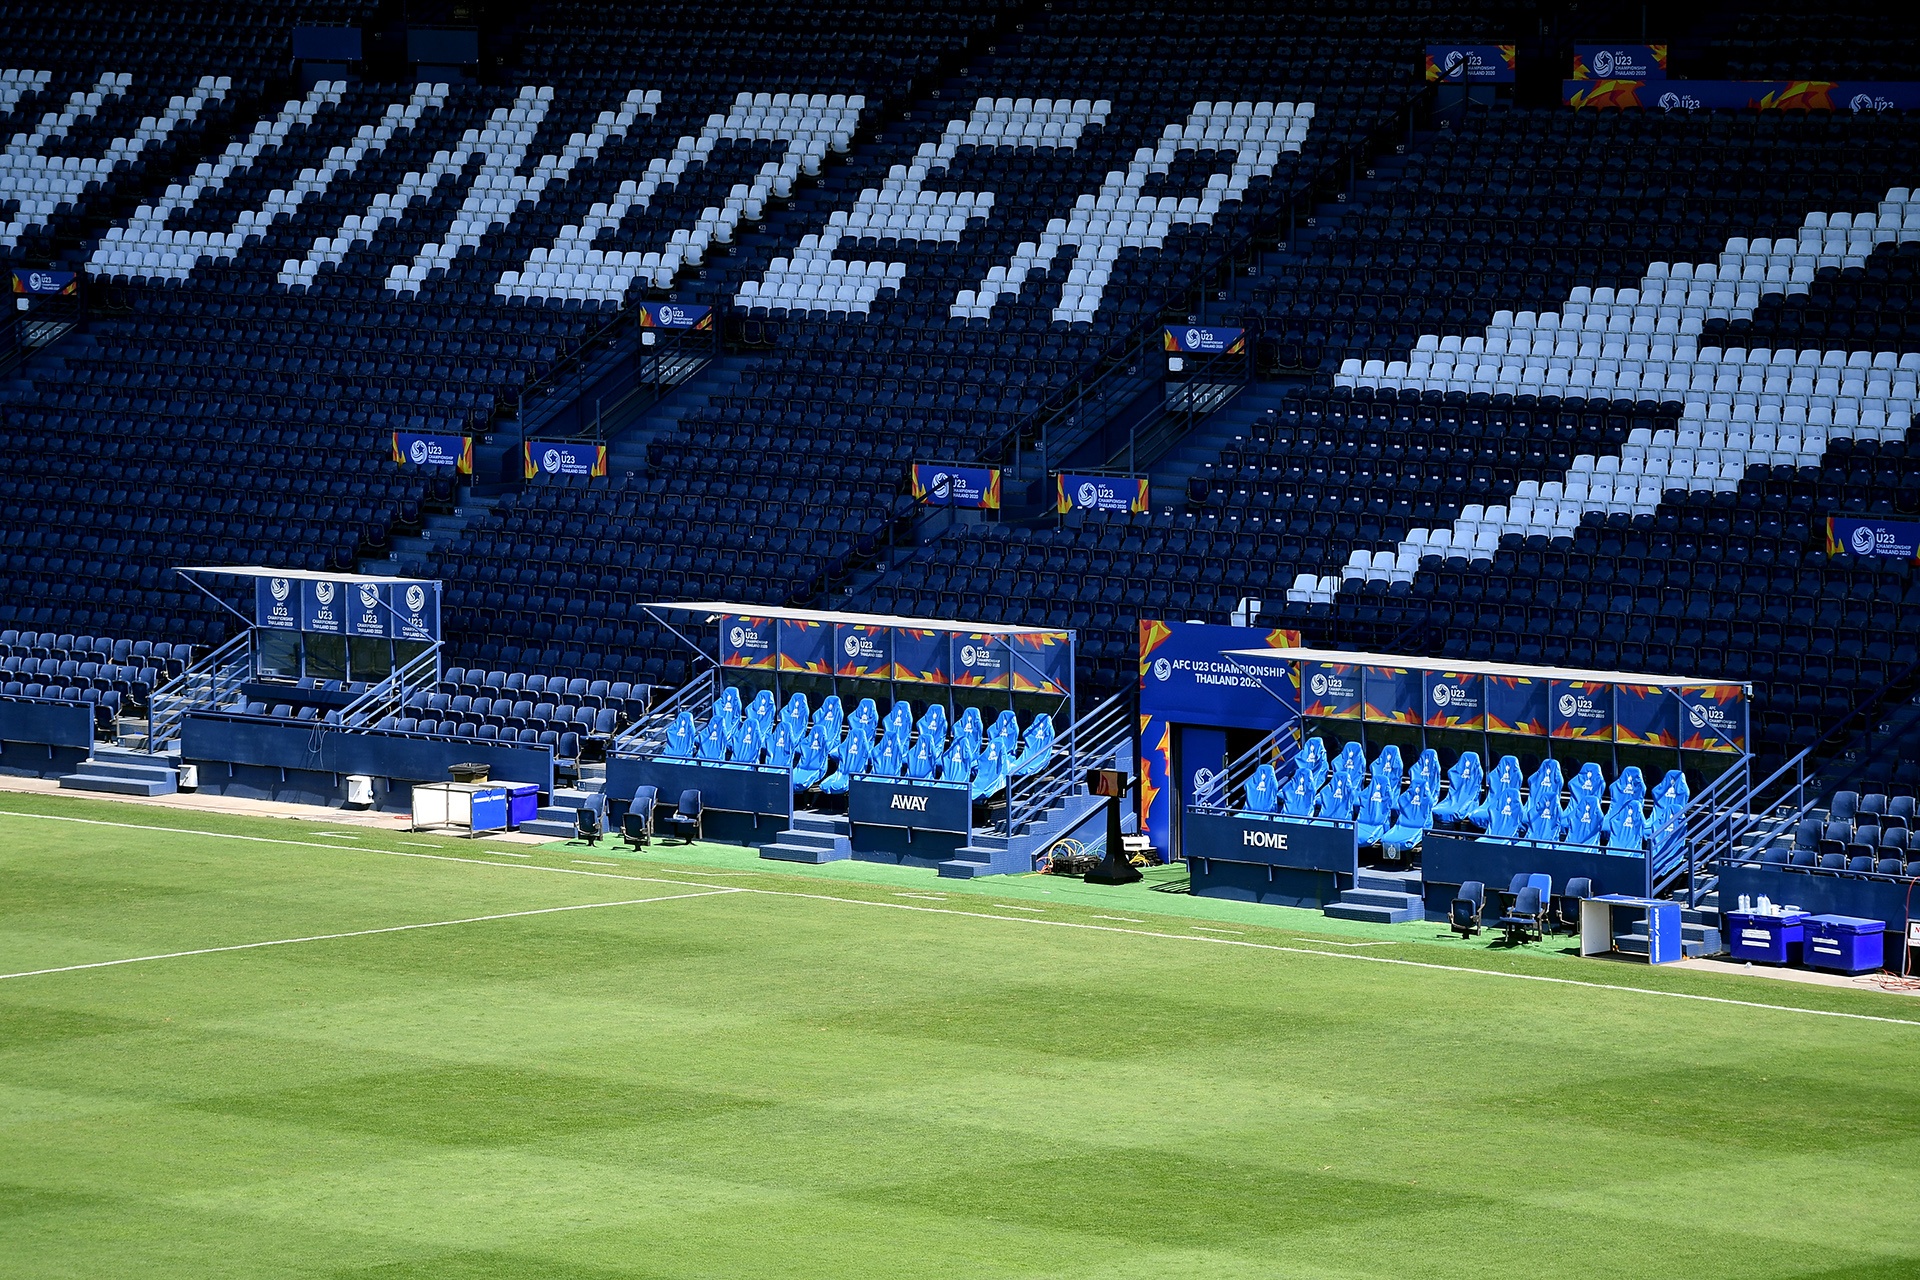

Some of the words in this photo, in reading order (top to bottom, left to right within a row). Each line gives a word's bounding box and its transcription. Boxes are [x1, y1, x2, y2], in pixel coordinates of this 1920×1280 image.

[1615, 56, 1632, 66] U23
[1682, 100, 1700, 110] U23
[428, 446, 442, 454] U23
[561, 455, 576, 464] U23
[1098, 489, 1114, 498] U23
[1876, 534, 1896, 544] U23
[273, 606, 288, 616] U23
[318, 610, 332, 620] U23
[362, 614, 378, 624] U23
[745, 632, 758, 640] U23
[860, 640, 872, 648] U23
[976, 650, 990, 658] U23
[1172, 659, 1191, 670] AFC
[1193, 662, 1210, 672] U23
[1211, 664, 1286, 678] CHAMPIONSHIP
[1195, 673, 1238, 686] THAILAND
[1328, 679, 1342, 688] U23
[1450, 689, 1466, 698] U23
[1578, 700, 1592, 708] U23
[1708, 710, 1724, 719] U23
[890, 794, 928, 812] AWAY
[1243, 830, 1288, 850] HOME
